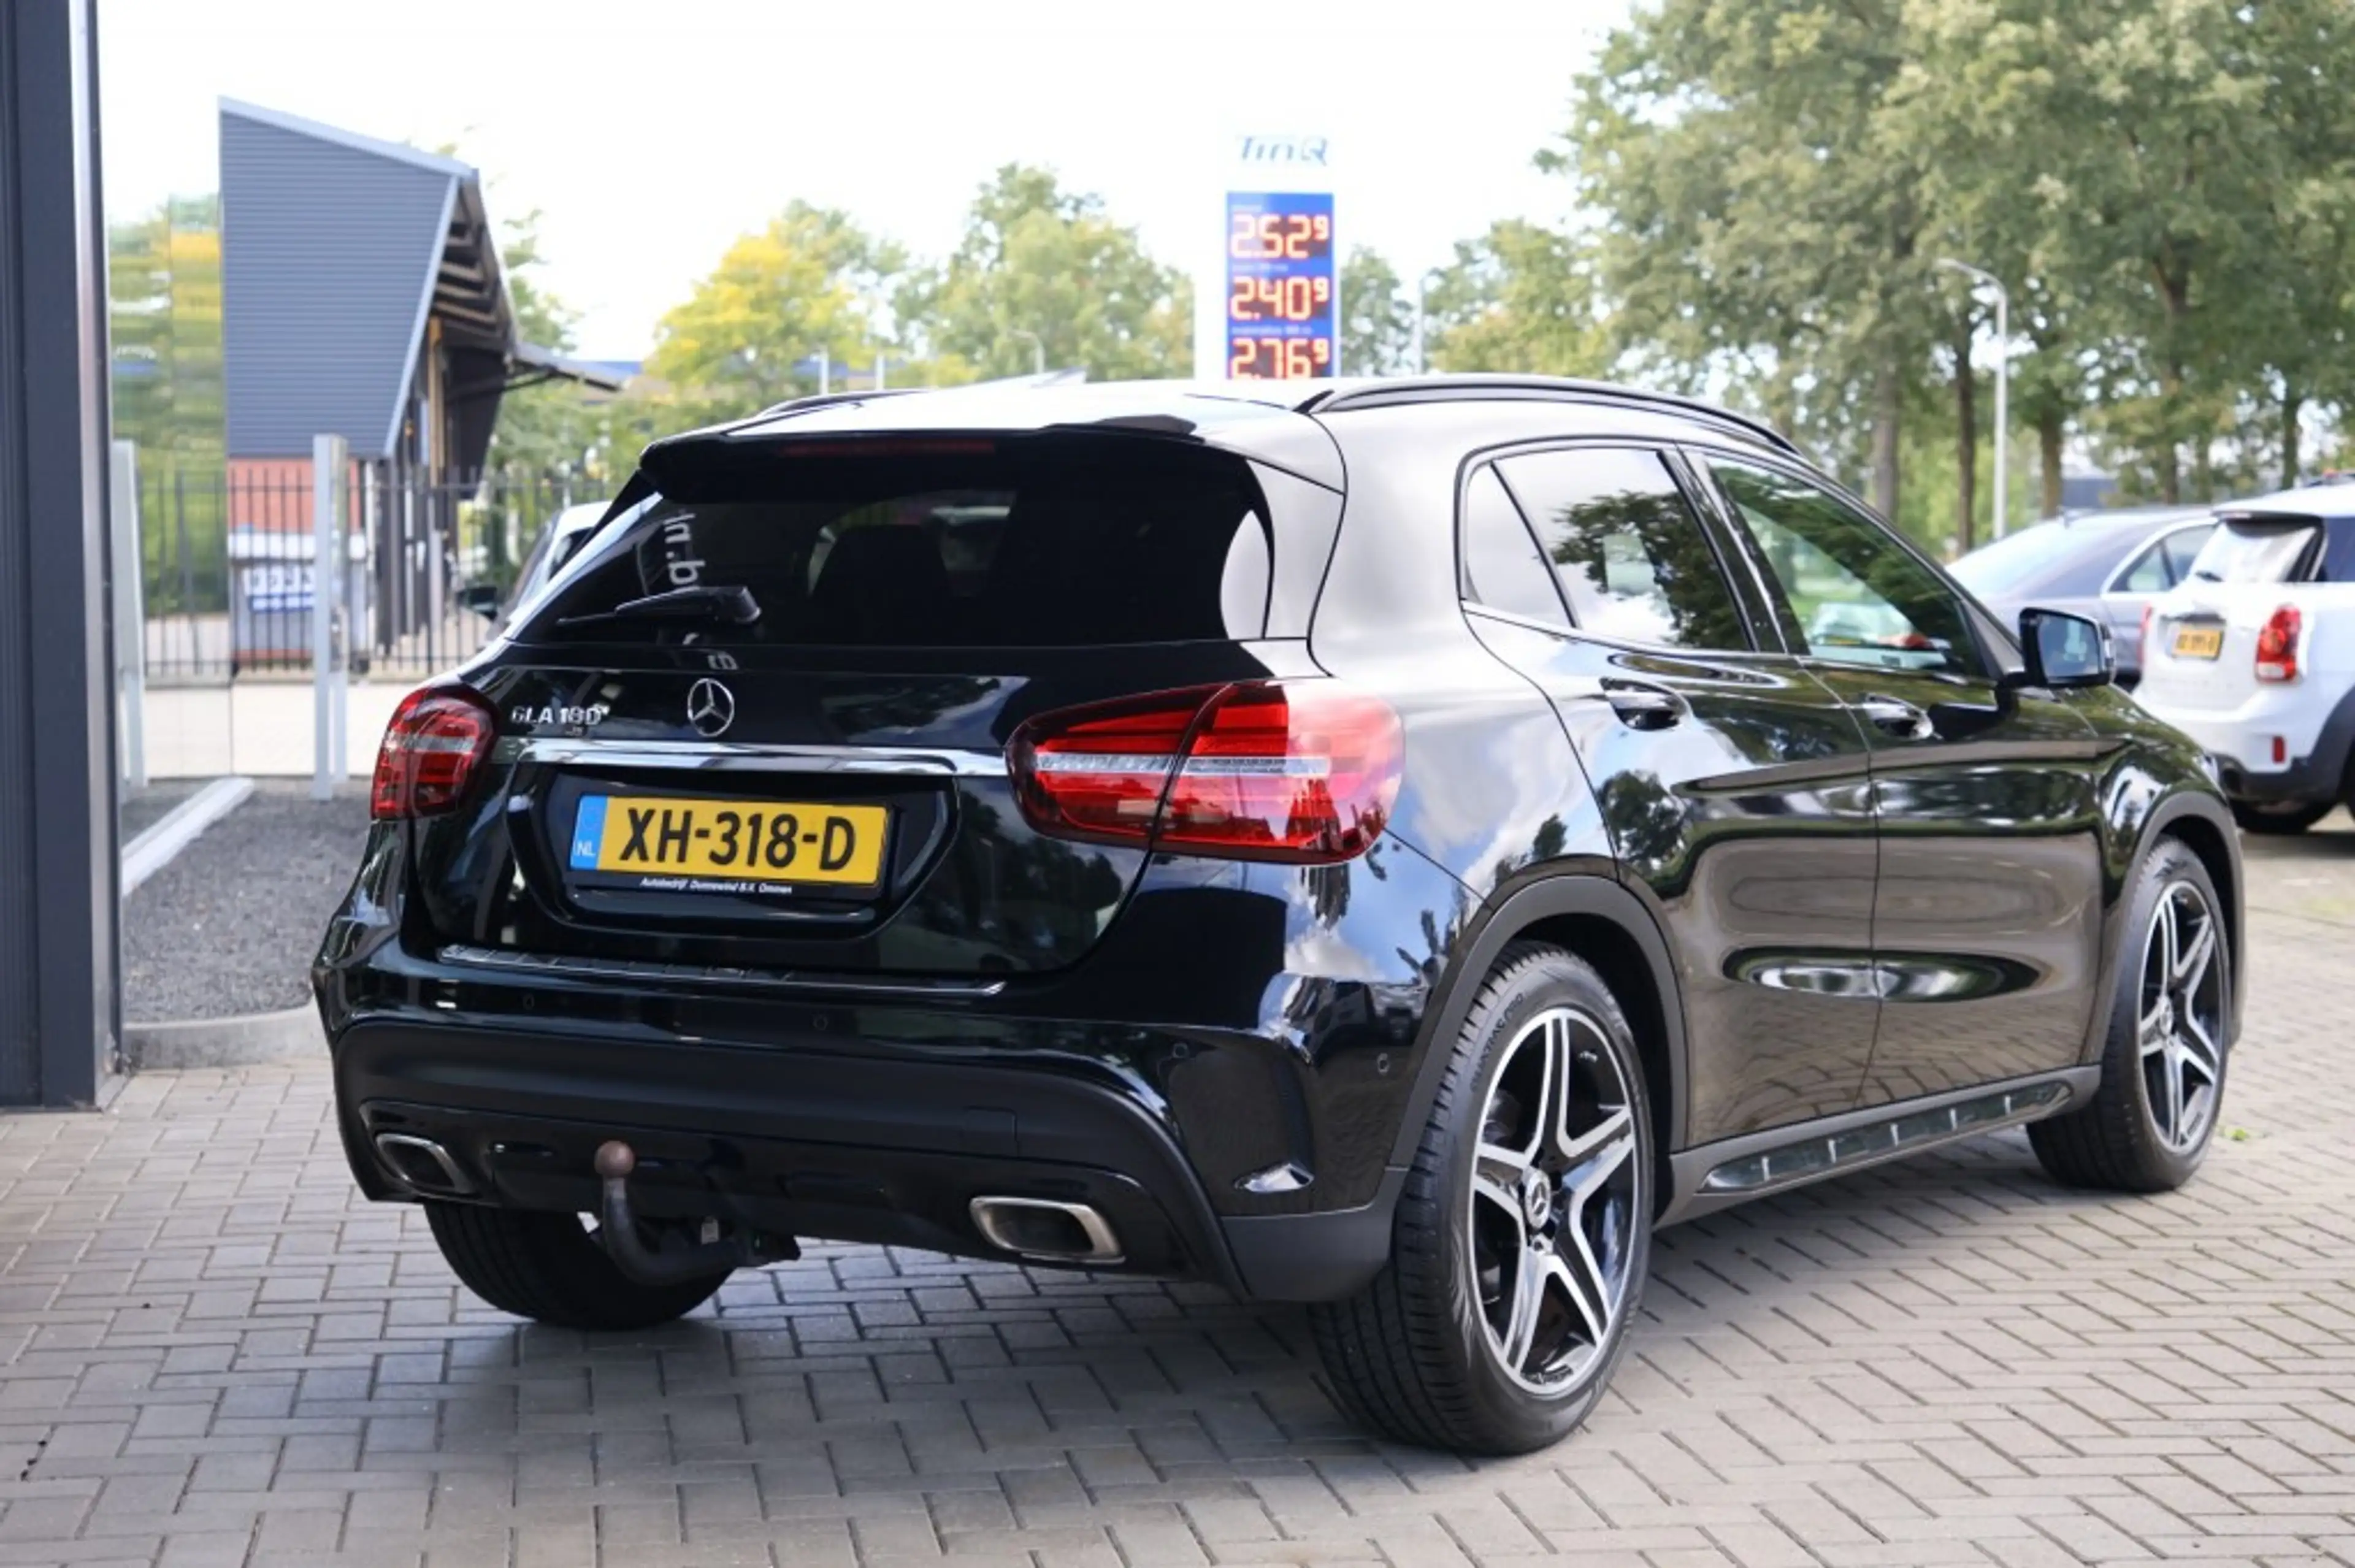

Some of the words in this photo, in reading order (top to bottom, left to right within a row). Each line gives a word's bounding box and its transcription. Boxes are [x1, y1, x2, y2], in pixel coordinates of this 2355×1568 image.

[510, 705, 553, 724] GLA
[619, 807, 856, 871] XH-318-D
[576, 841, 596, 857] NL
